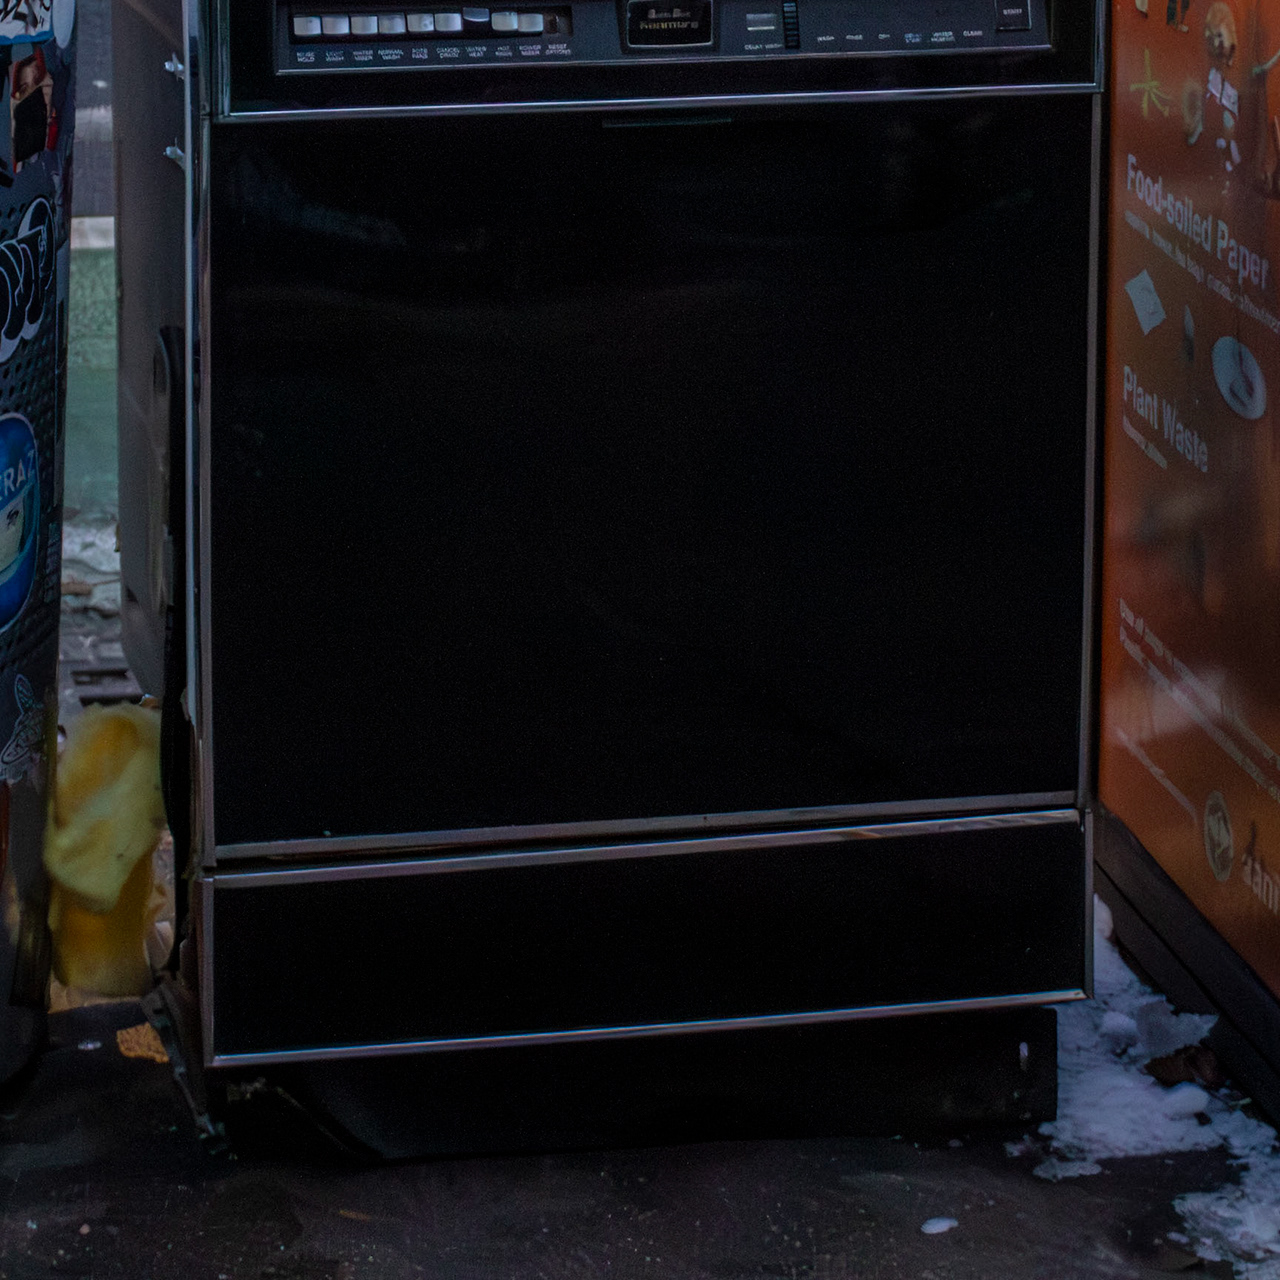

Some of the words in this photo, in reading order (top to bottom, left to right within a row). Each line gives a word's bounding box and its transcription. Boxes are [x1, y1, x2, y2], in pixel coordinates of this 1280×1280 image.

[1127, 152, 1213, 253] Food-soiled
[1216, 219, 1270, 291] Paper
[1123, 364, 1159, 430] Plant
[1162, 398, 1209, 473] Waste
